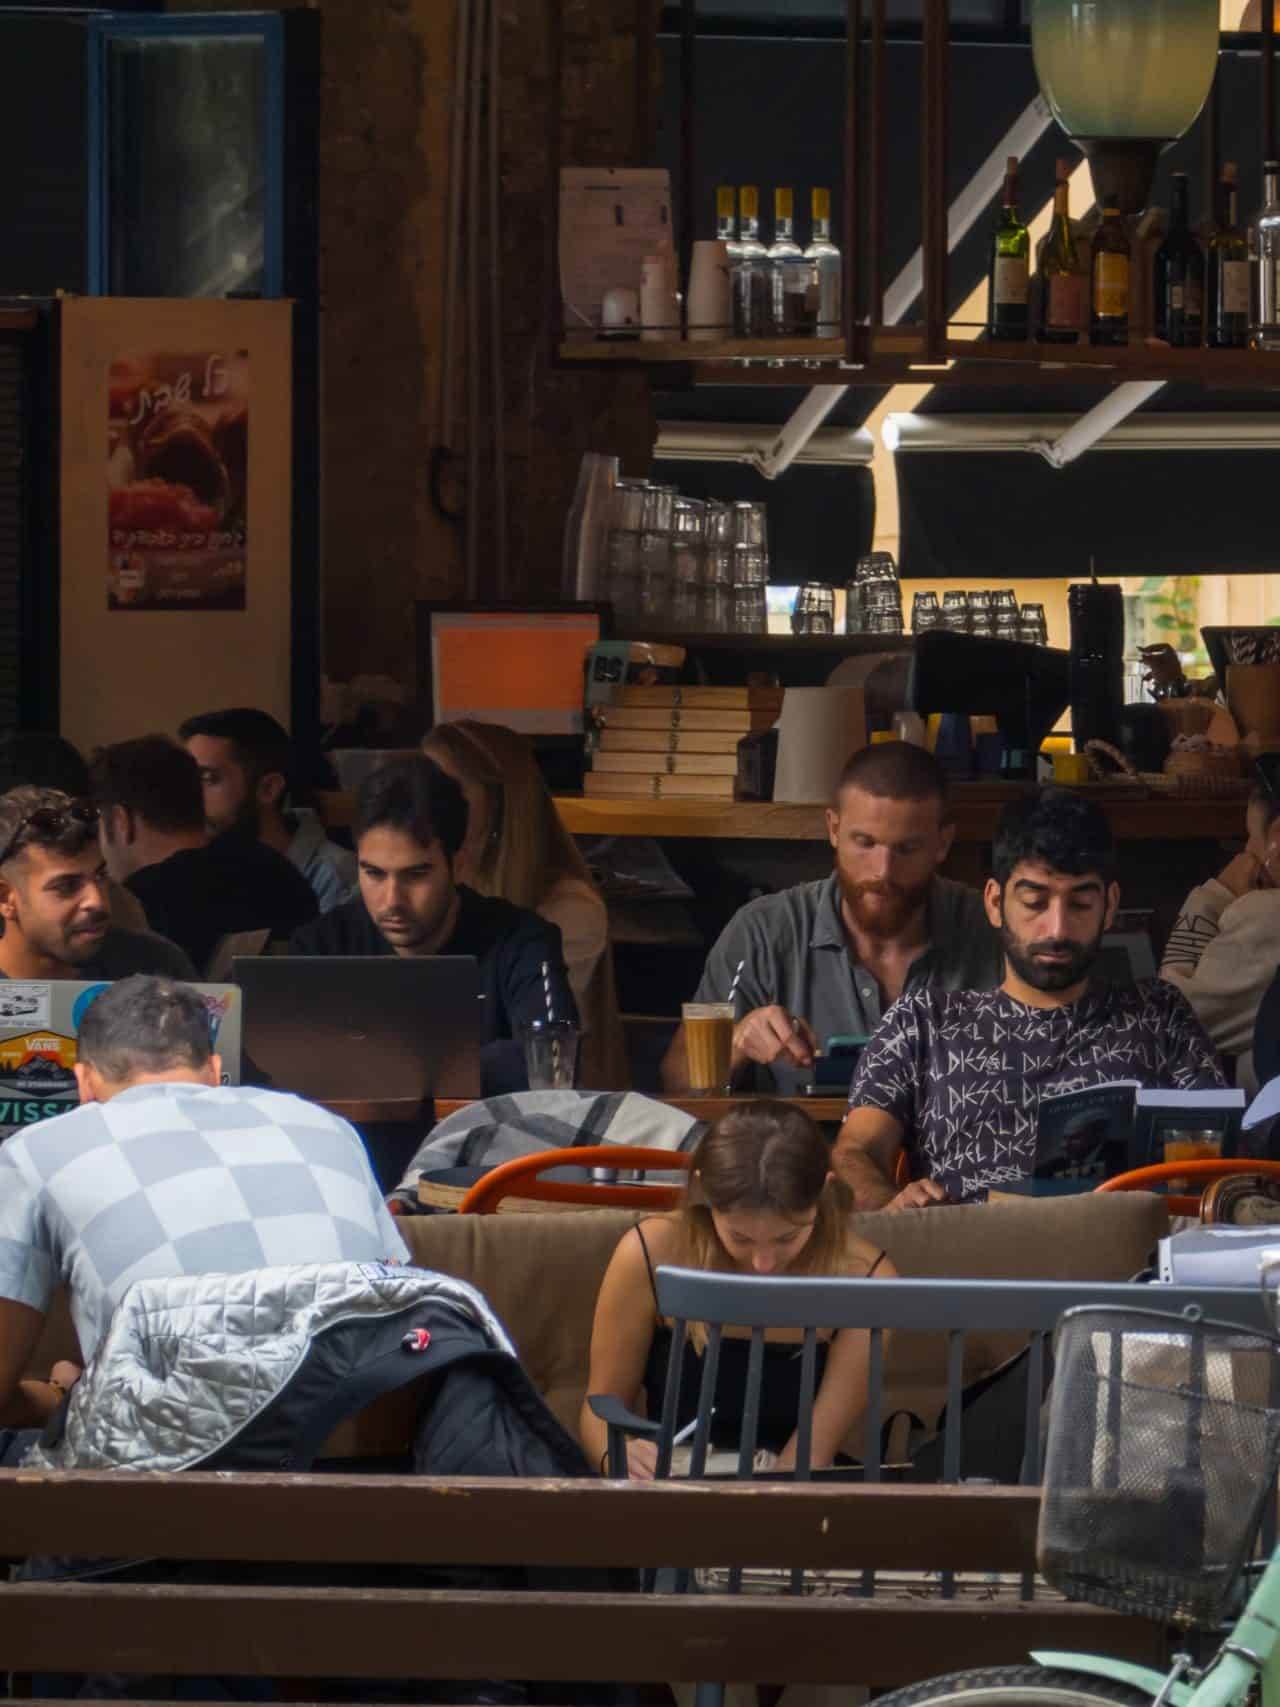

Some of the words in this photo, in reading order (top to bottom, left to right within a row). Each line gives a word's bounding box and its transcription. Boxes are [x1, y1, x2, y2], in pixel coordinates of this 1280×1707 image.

[24, 1037, 62, 1056] VANS
[993, 1021, 1060, 1044] DIESEL
[947, 1047, 1016, 1076] DIESEL
[947, 1079, 1017, 1114] DIESEL
[944, 1107, 1013, 1150] DIESEL
[992, 1134, 1038, 1164] DIES
